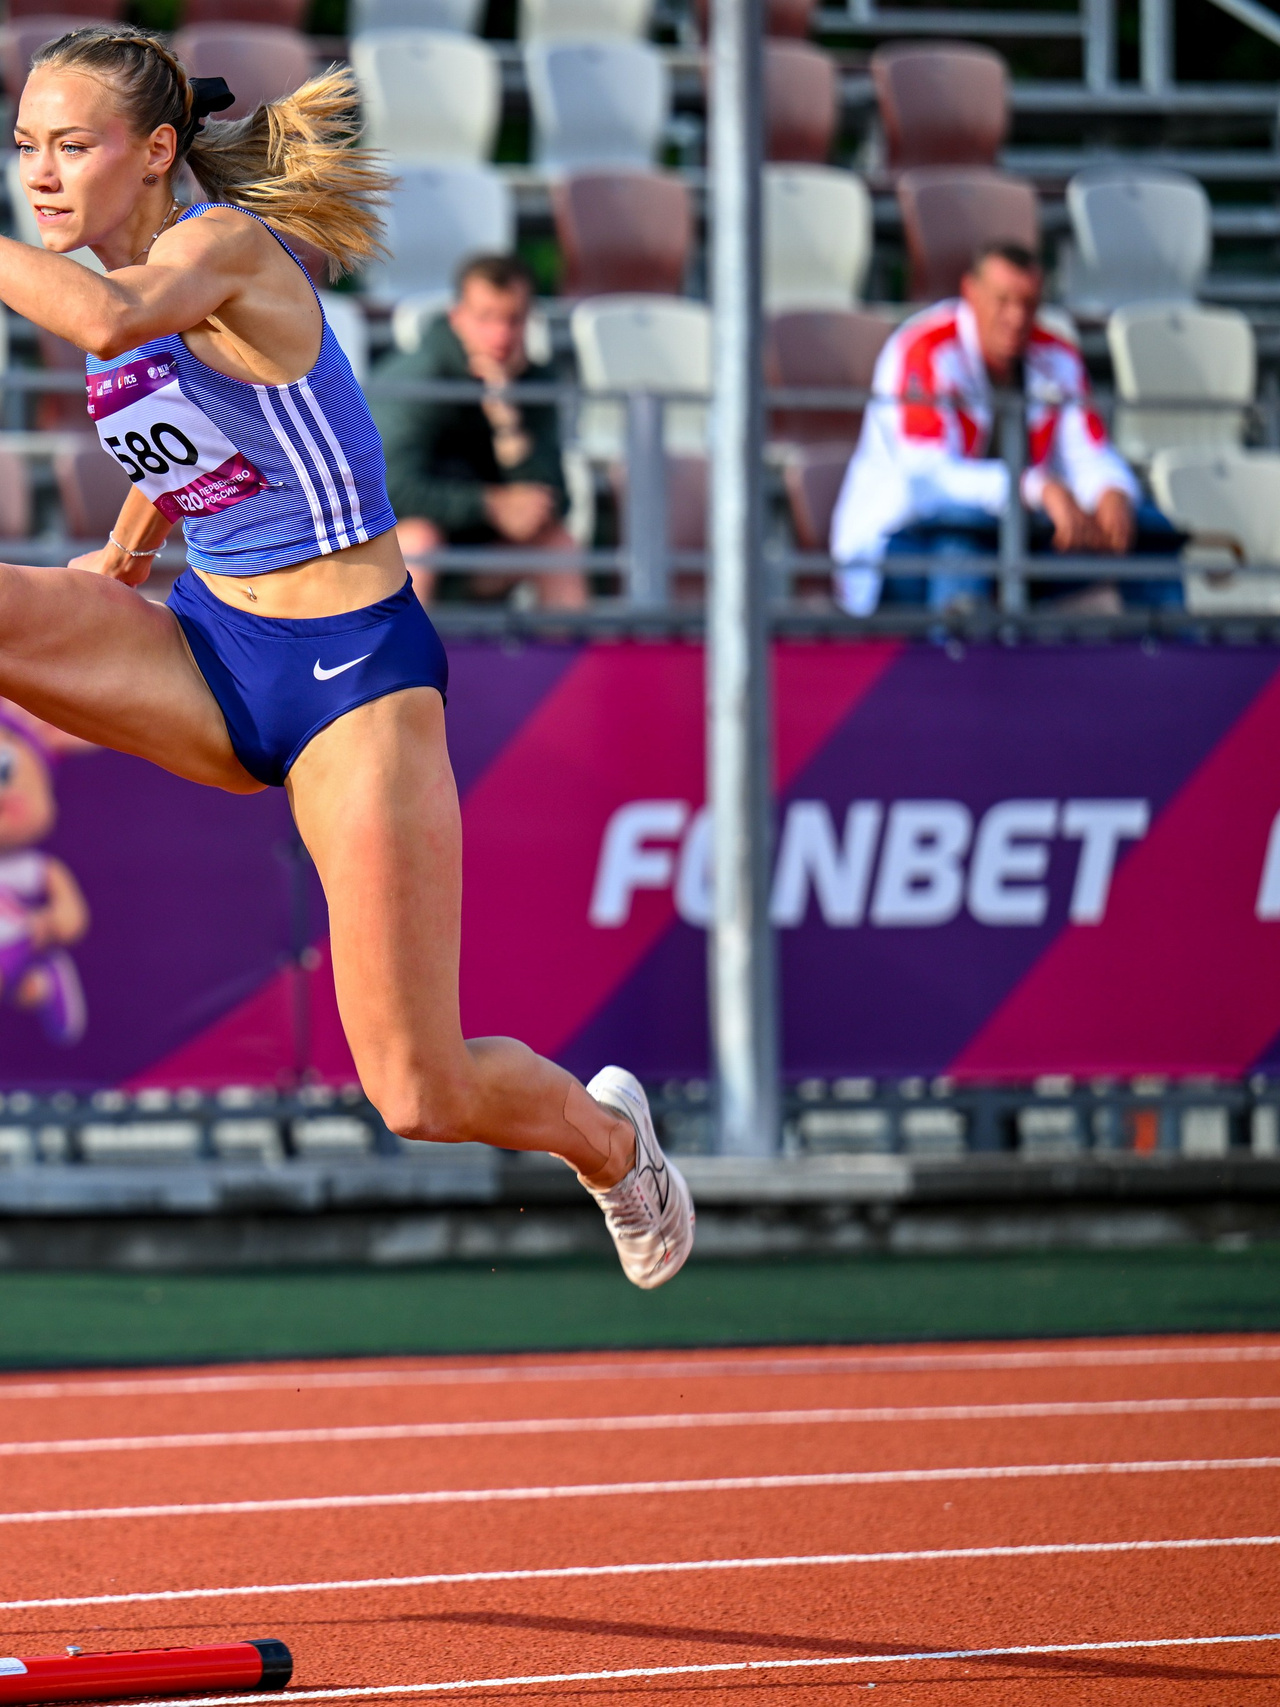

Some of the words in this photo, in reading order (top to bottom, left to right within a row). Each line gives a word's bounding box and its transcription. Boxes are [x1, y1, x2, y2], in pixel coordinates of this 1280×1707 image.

[123, 374, 137, 386] ПСБ
[104, 422, 198, 483] 580
[199, 470, 250, 496] ПЕРВЕНСТВО
[173, 492, 204, 511] U20
[205, 486, 239, 506] РОССИИ
